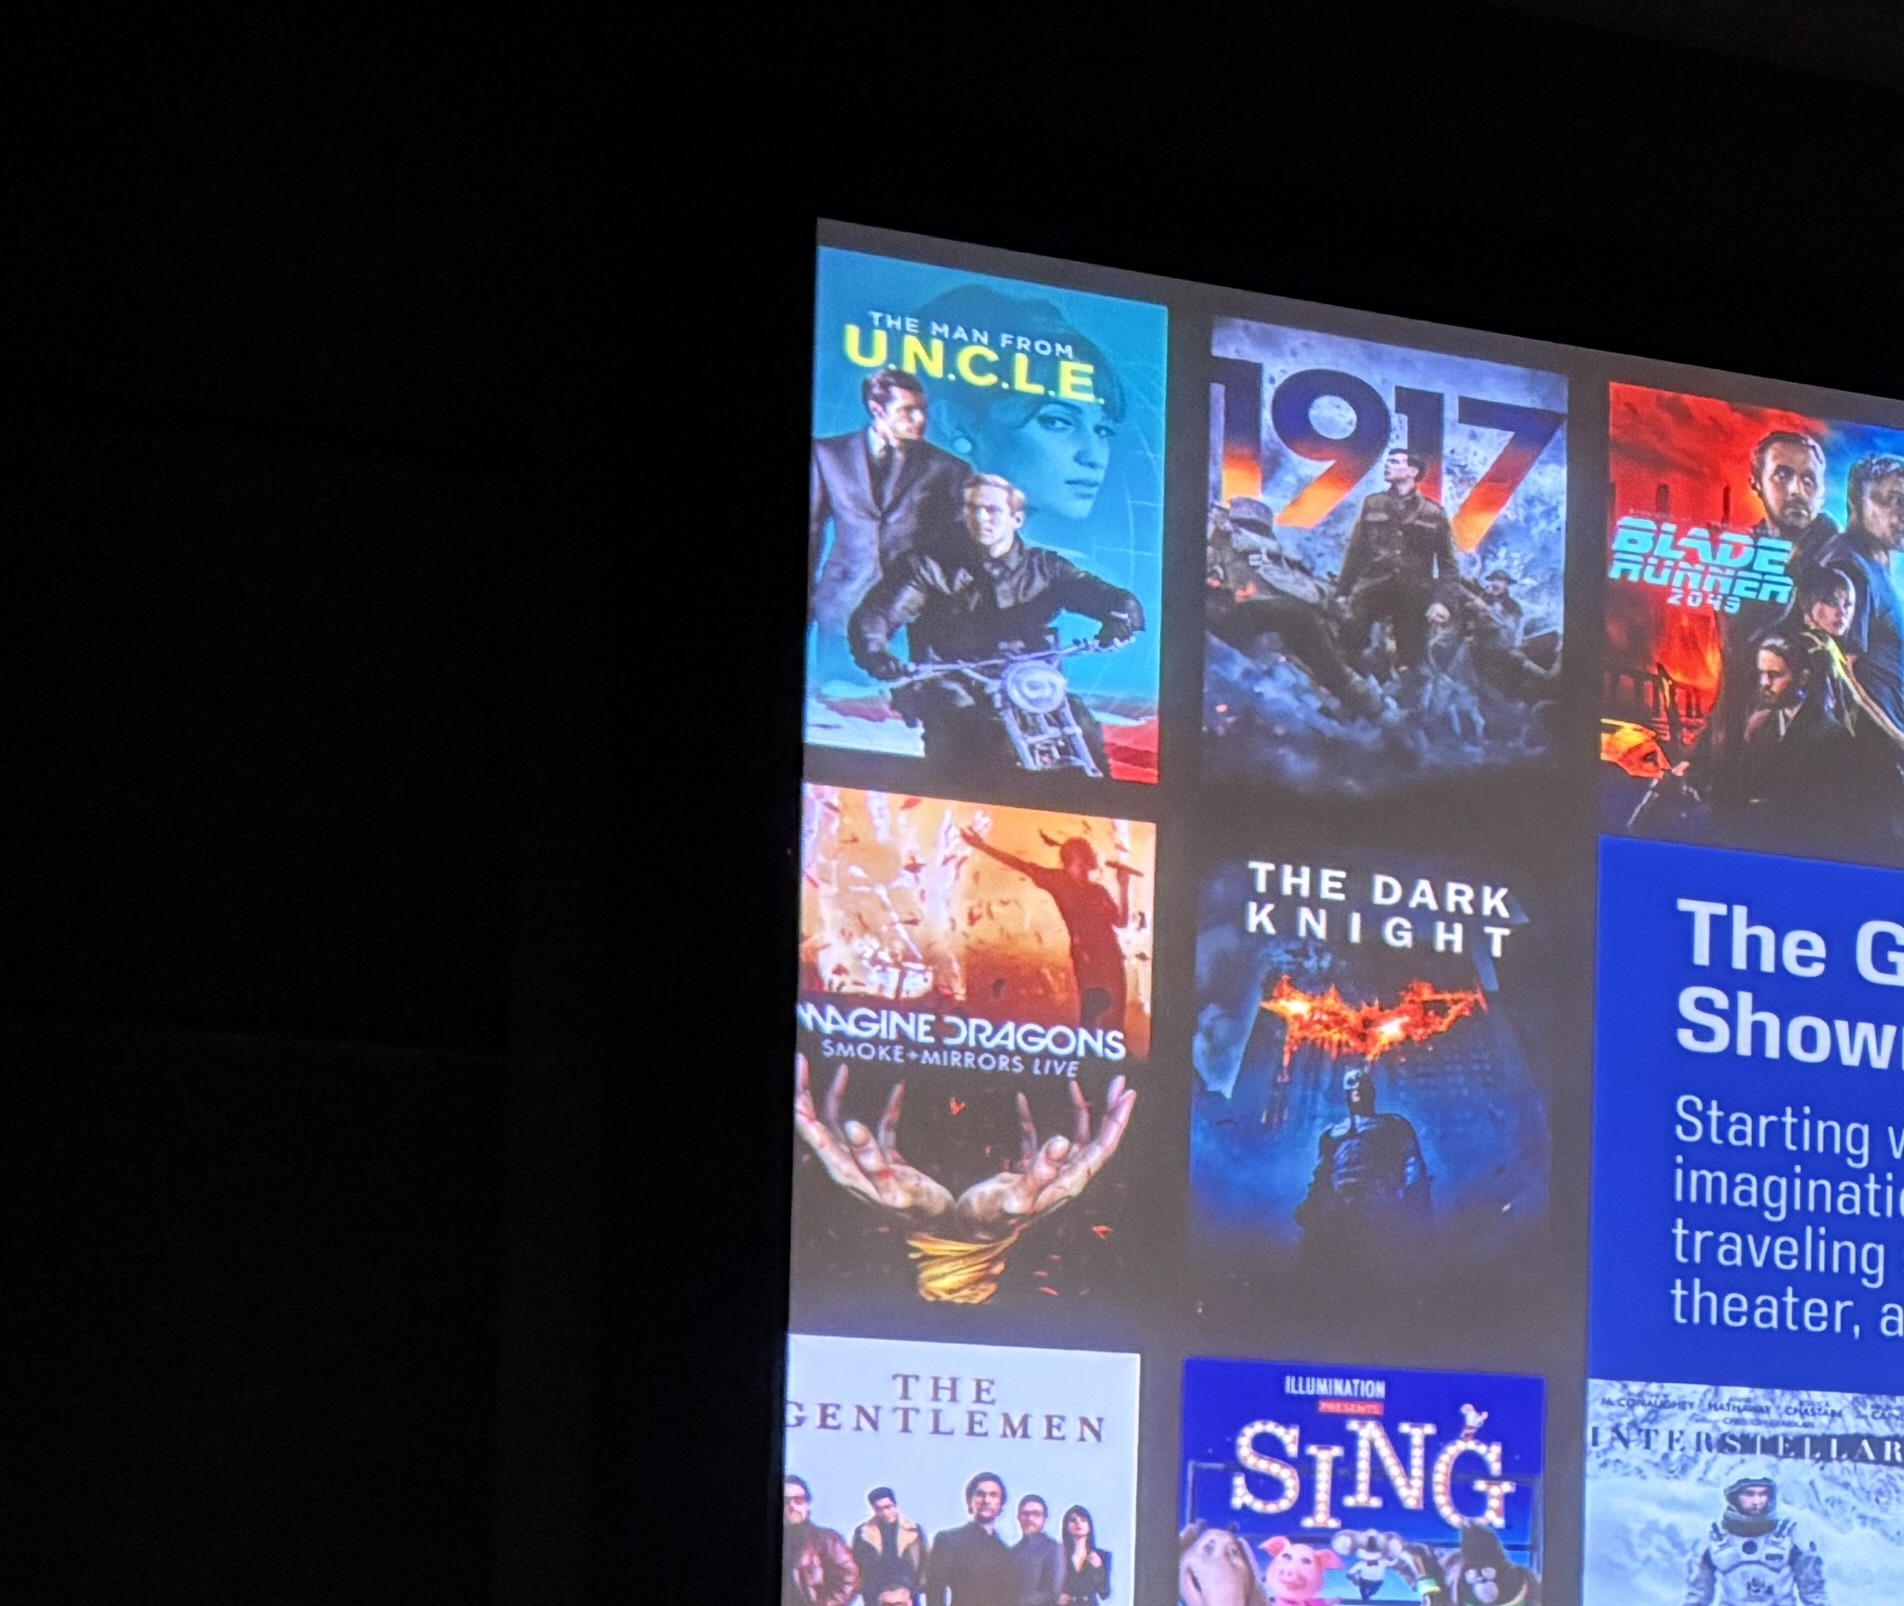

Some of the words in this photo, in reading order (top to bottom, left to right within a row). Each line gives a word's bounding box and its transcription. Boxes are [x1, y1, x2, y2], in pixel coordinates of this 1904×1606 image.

[868, 311, 919, 333] THE
[930, 321, 988, 345] MAN
[1000, 332, 1073, 358] FROM
[844, 324, 1105, 404] U.N.C.L.E.
[1207, 355, 1568, 553] 1917
[1612, 516, 1792, 574] BLADE
[1608, 552, 1794, 603] RUNNER
[1667, 588, 1740, 614] 2049
[1248, 861, 1346, 901] THE
[1372, 873, 1510, 918] DARK
[1246, 901, 1511, 958] KNIGHT
[1677, 899, 1827, 978] The
[943, 1015, 1126, 1060] DRAGONS
[1033, 1059, 1079, 1078] LIVE
[1675, 1095, 1869, 1169] Starting
[1672, 1218, 1884, 1289] traveling
[1670, 1278, 1860, 1340] theater,
[891, 1373, 997, 1405] THE
[1285, 1375, 1386, 1399] ILLUMINATION
[786, 1400, 1104, 1442] GENTLEMEN
[1591, 1425, 1903, 1463] INTERSTELLAR
[1231, 1419, 1516, 1528] SING
